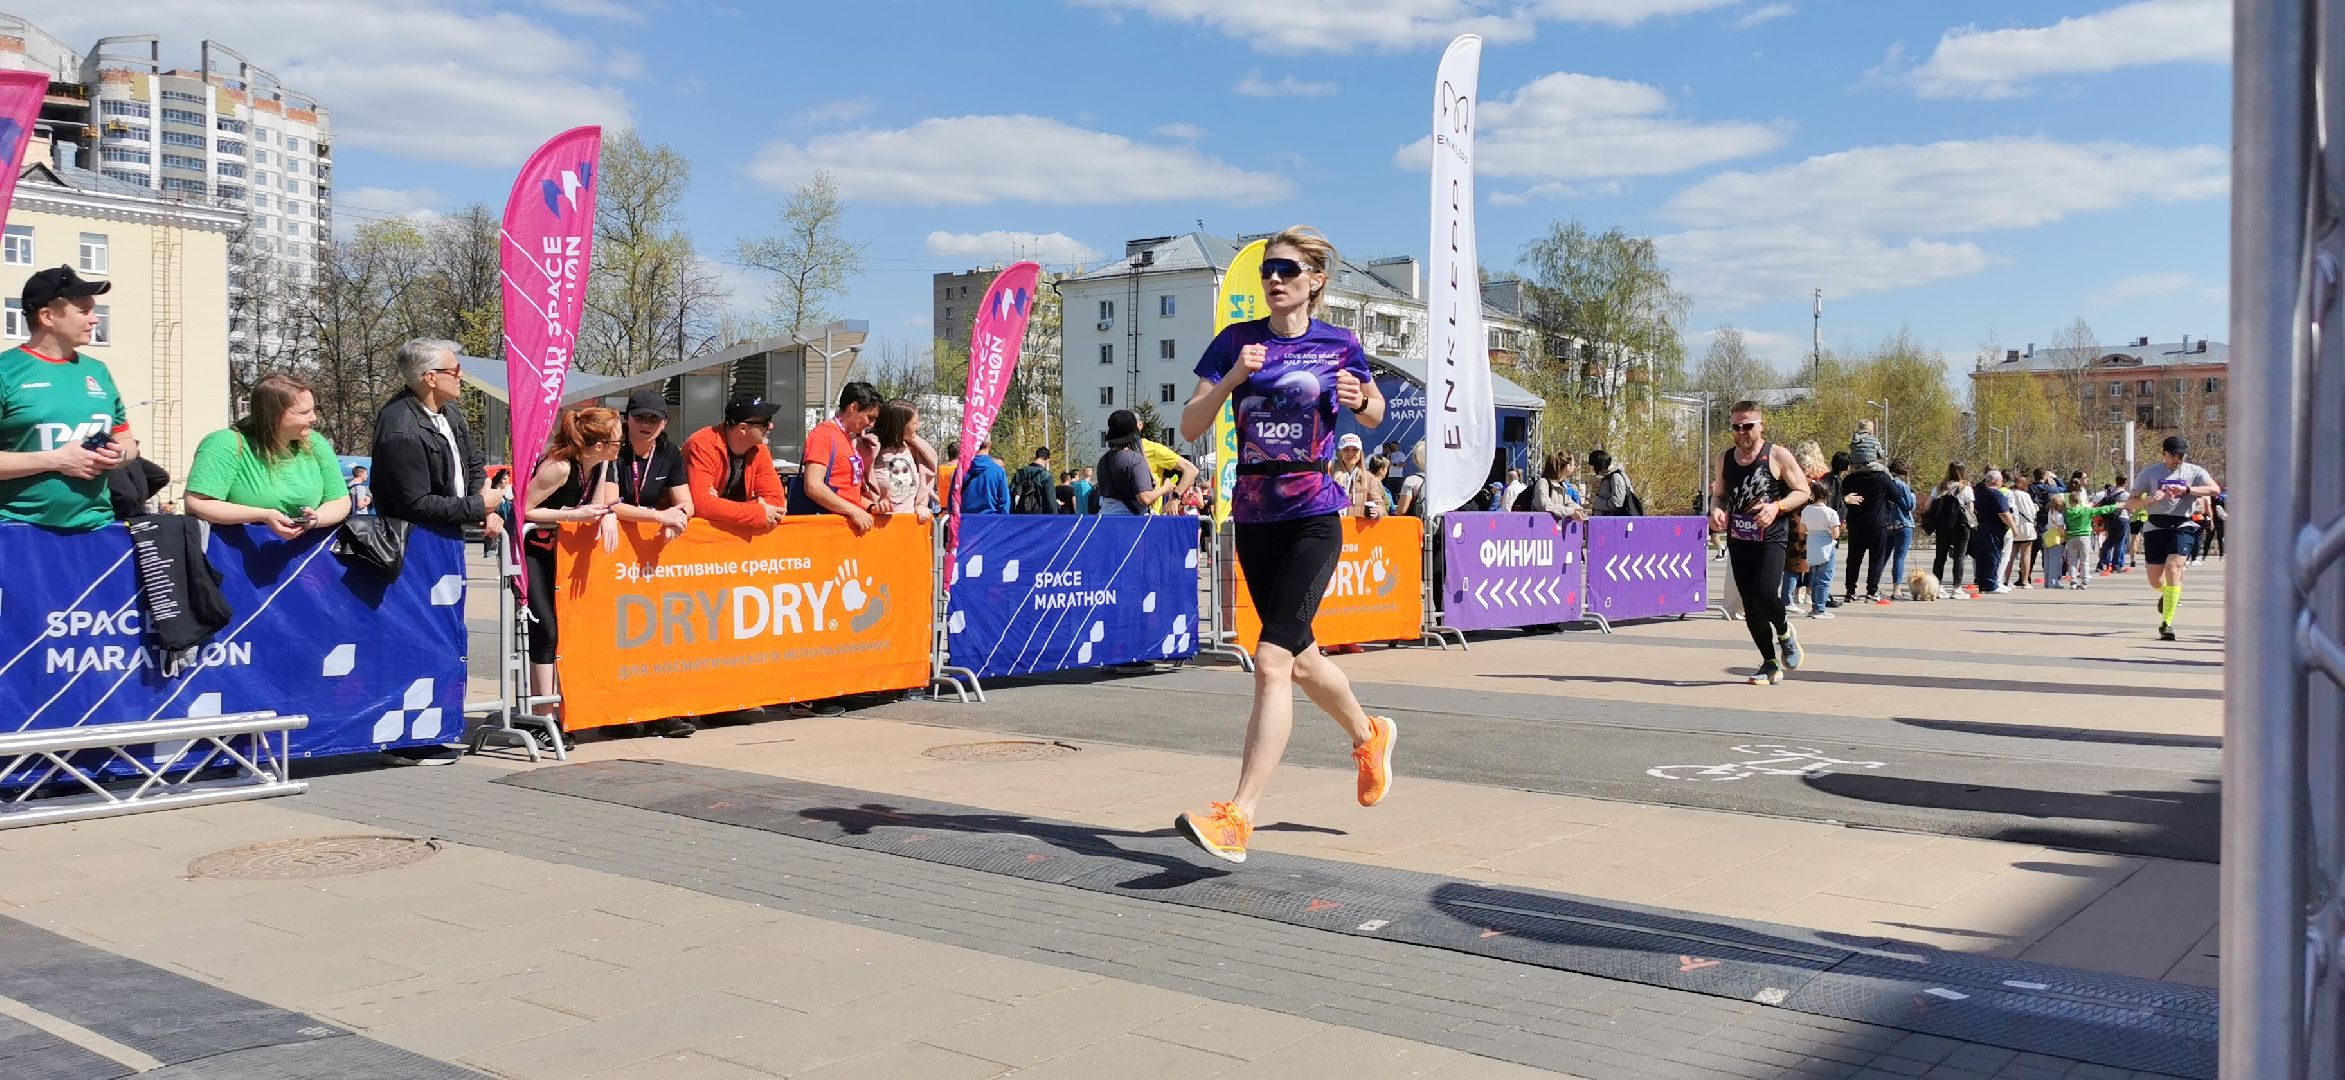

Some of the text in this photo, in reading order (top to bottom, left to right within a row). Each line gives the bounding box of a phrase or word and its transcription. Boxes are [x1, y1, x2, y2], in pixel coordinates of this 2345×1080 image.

[1389, 396, 1426, 409] SPACE
[1390, 409, 1426, 420] MARA
[1255, 421, 1303, 440] 1208
[1734, 519, 1758, 530] 1084
[1479, 539, 1554, 568] ФИНИШ
[615, 557, 812, 584] Эффективные средства
[1034, 570, 1082, 589] SPACE
[1034, 589, 1117, 610] MARATHON
[46, 641, 252, 674] MARAON
